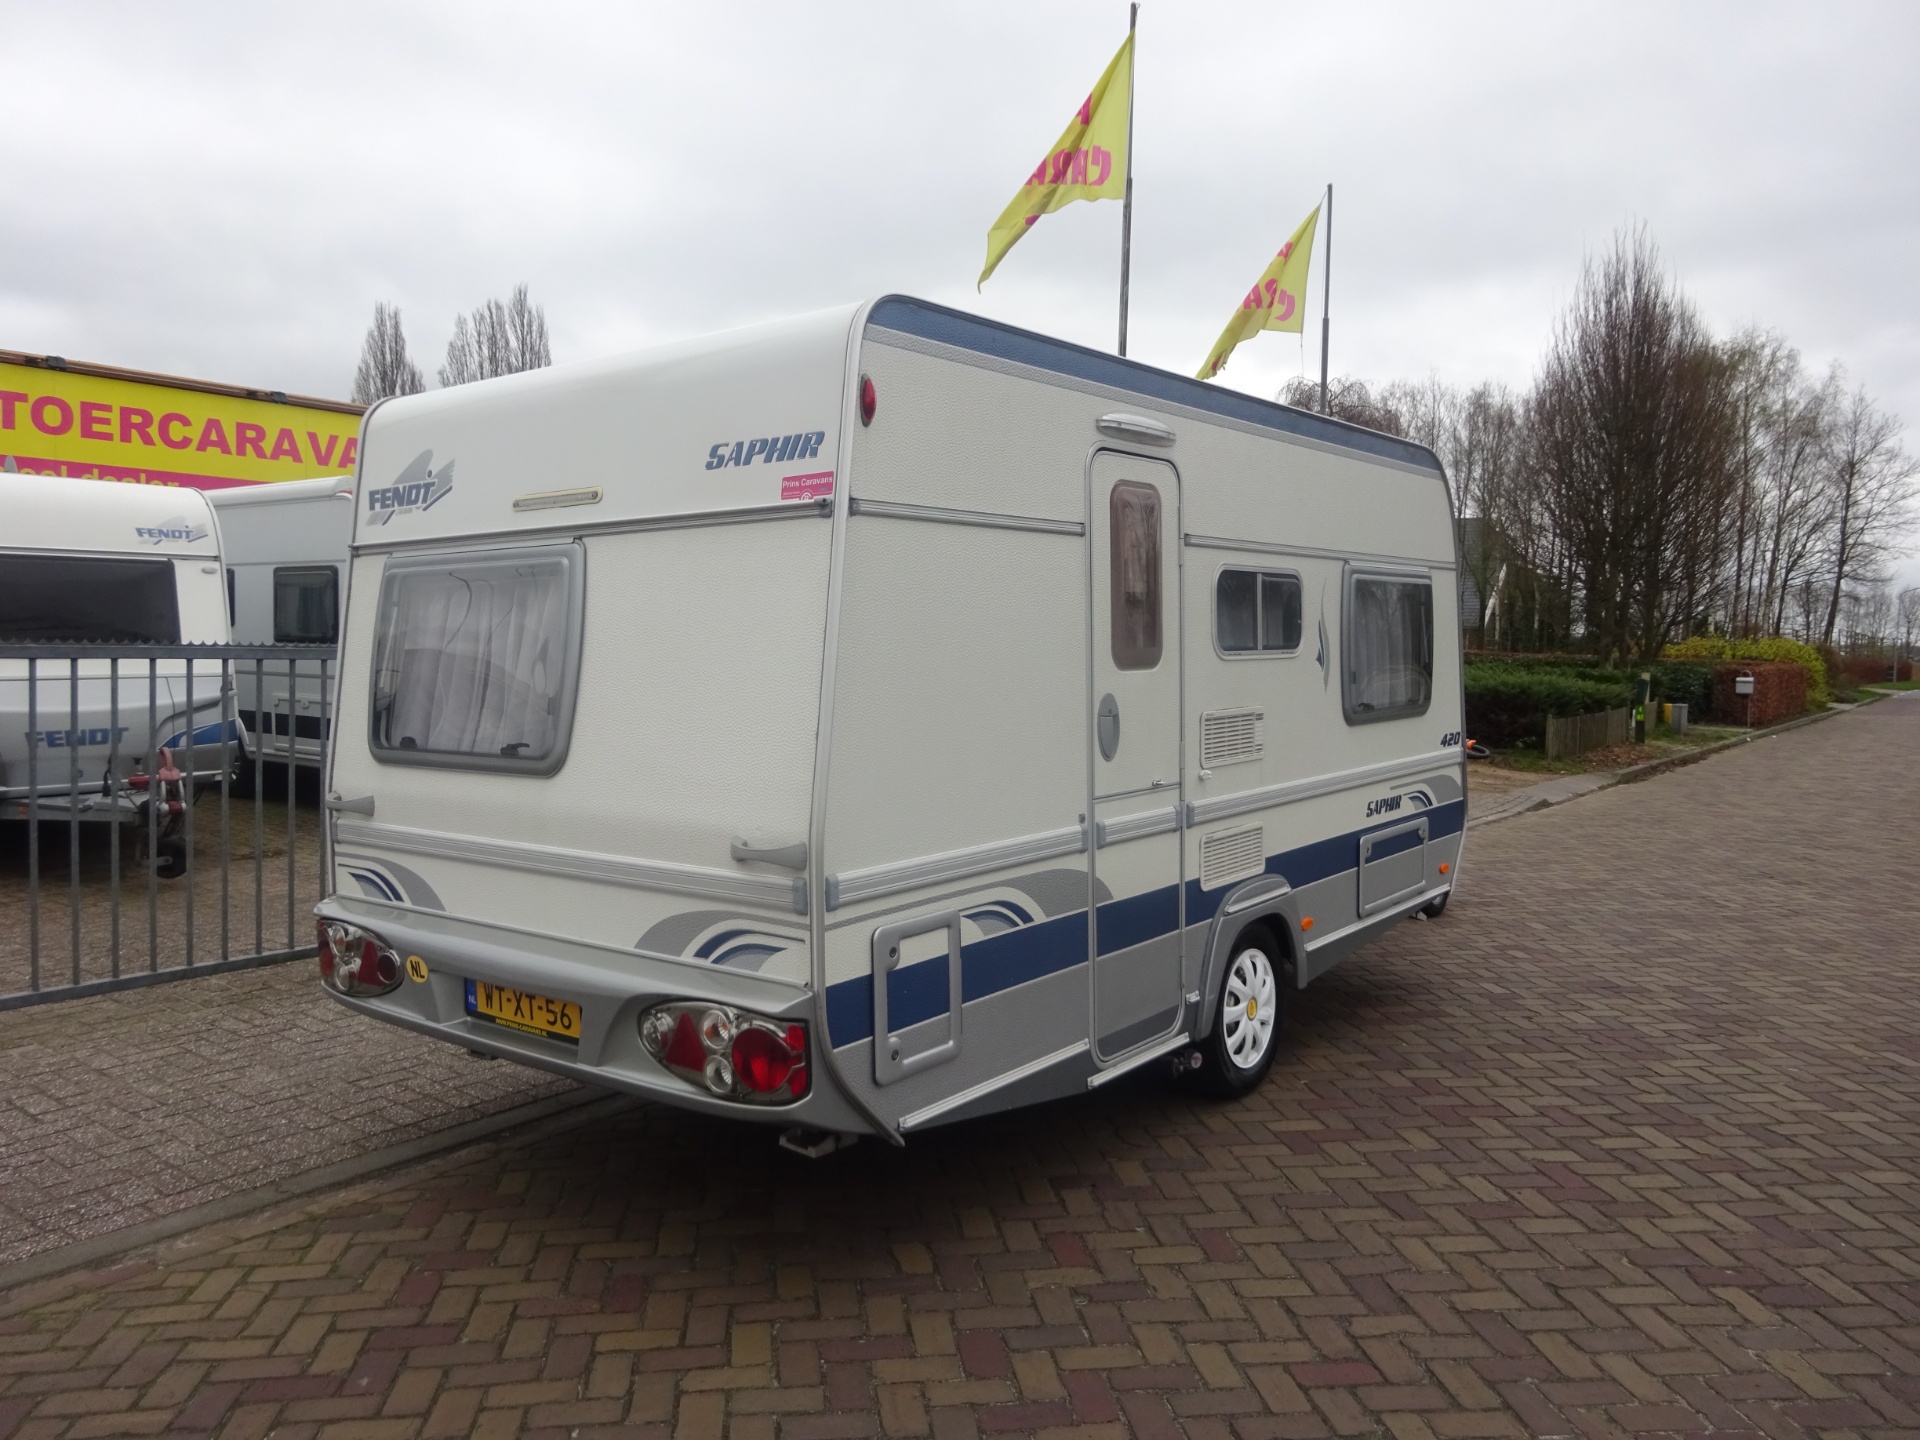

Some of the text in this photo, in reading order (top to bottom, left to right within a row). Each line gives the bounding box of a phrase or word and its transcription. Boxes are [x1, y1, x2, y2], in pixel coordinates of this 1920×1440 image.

[705, 431, 825, 470] SAPHIR
[801, 476, 833, 486] Caravans
[368, 480, 436, 511] FENDT
[135, 527, 194, 539] FENDT
[1440, 732, 1460, 747] 420
[1366, 795, 1402, 817] SAPHIR
[410, 960, 425, 979] NL
[468, 995, 477, 1004] NL
[484, 982, 572, 1030] WT-XT-56
